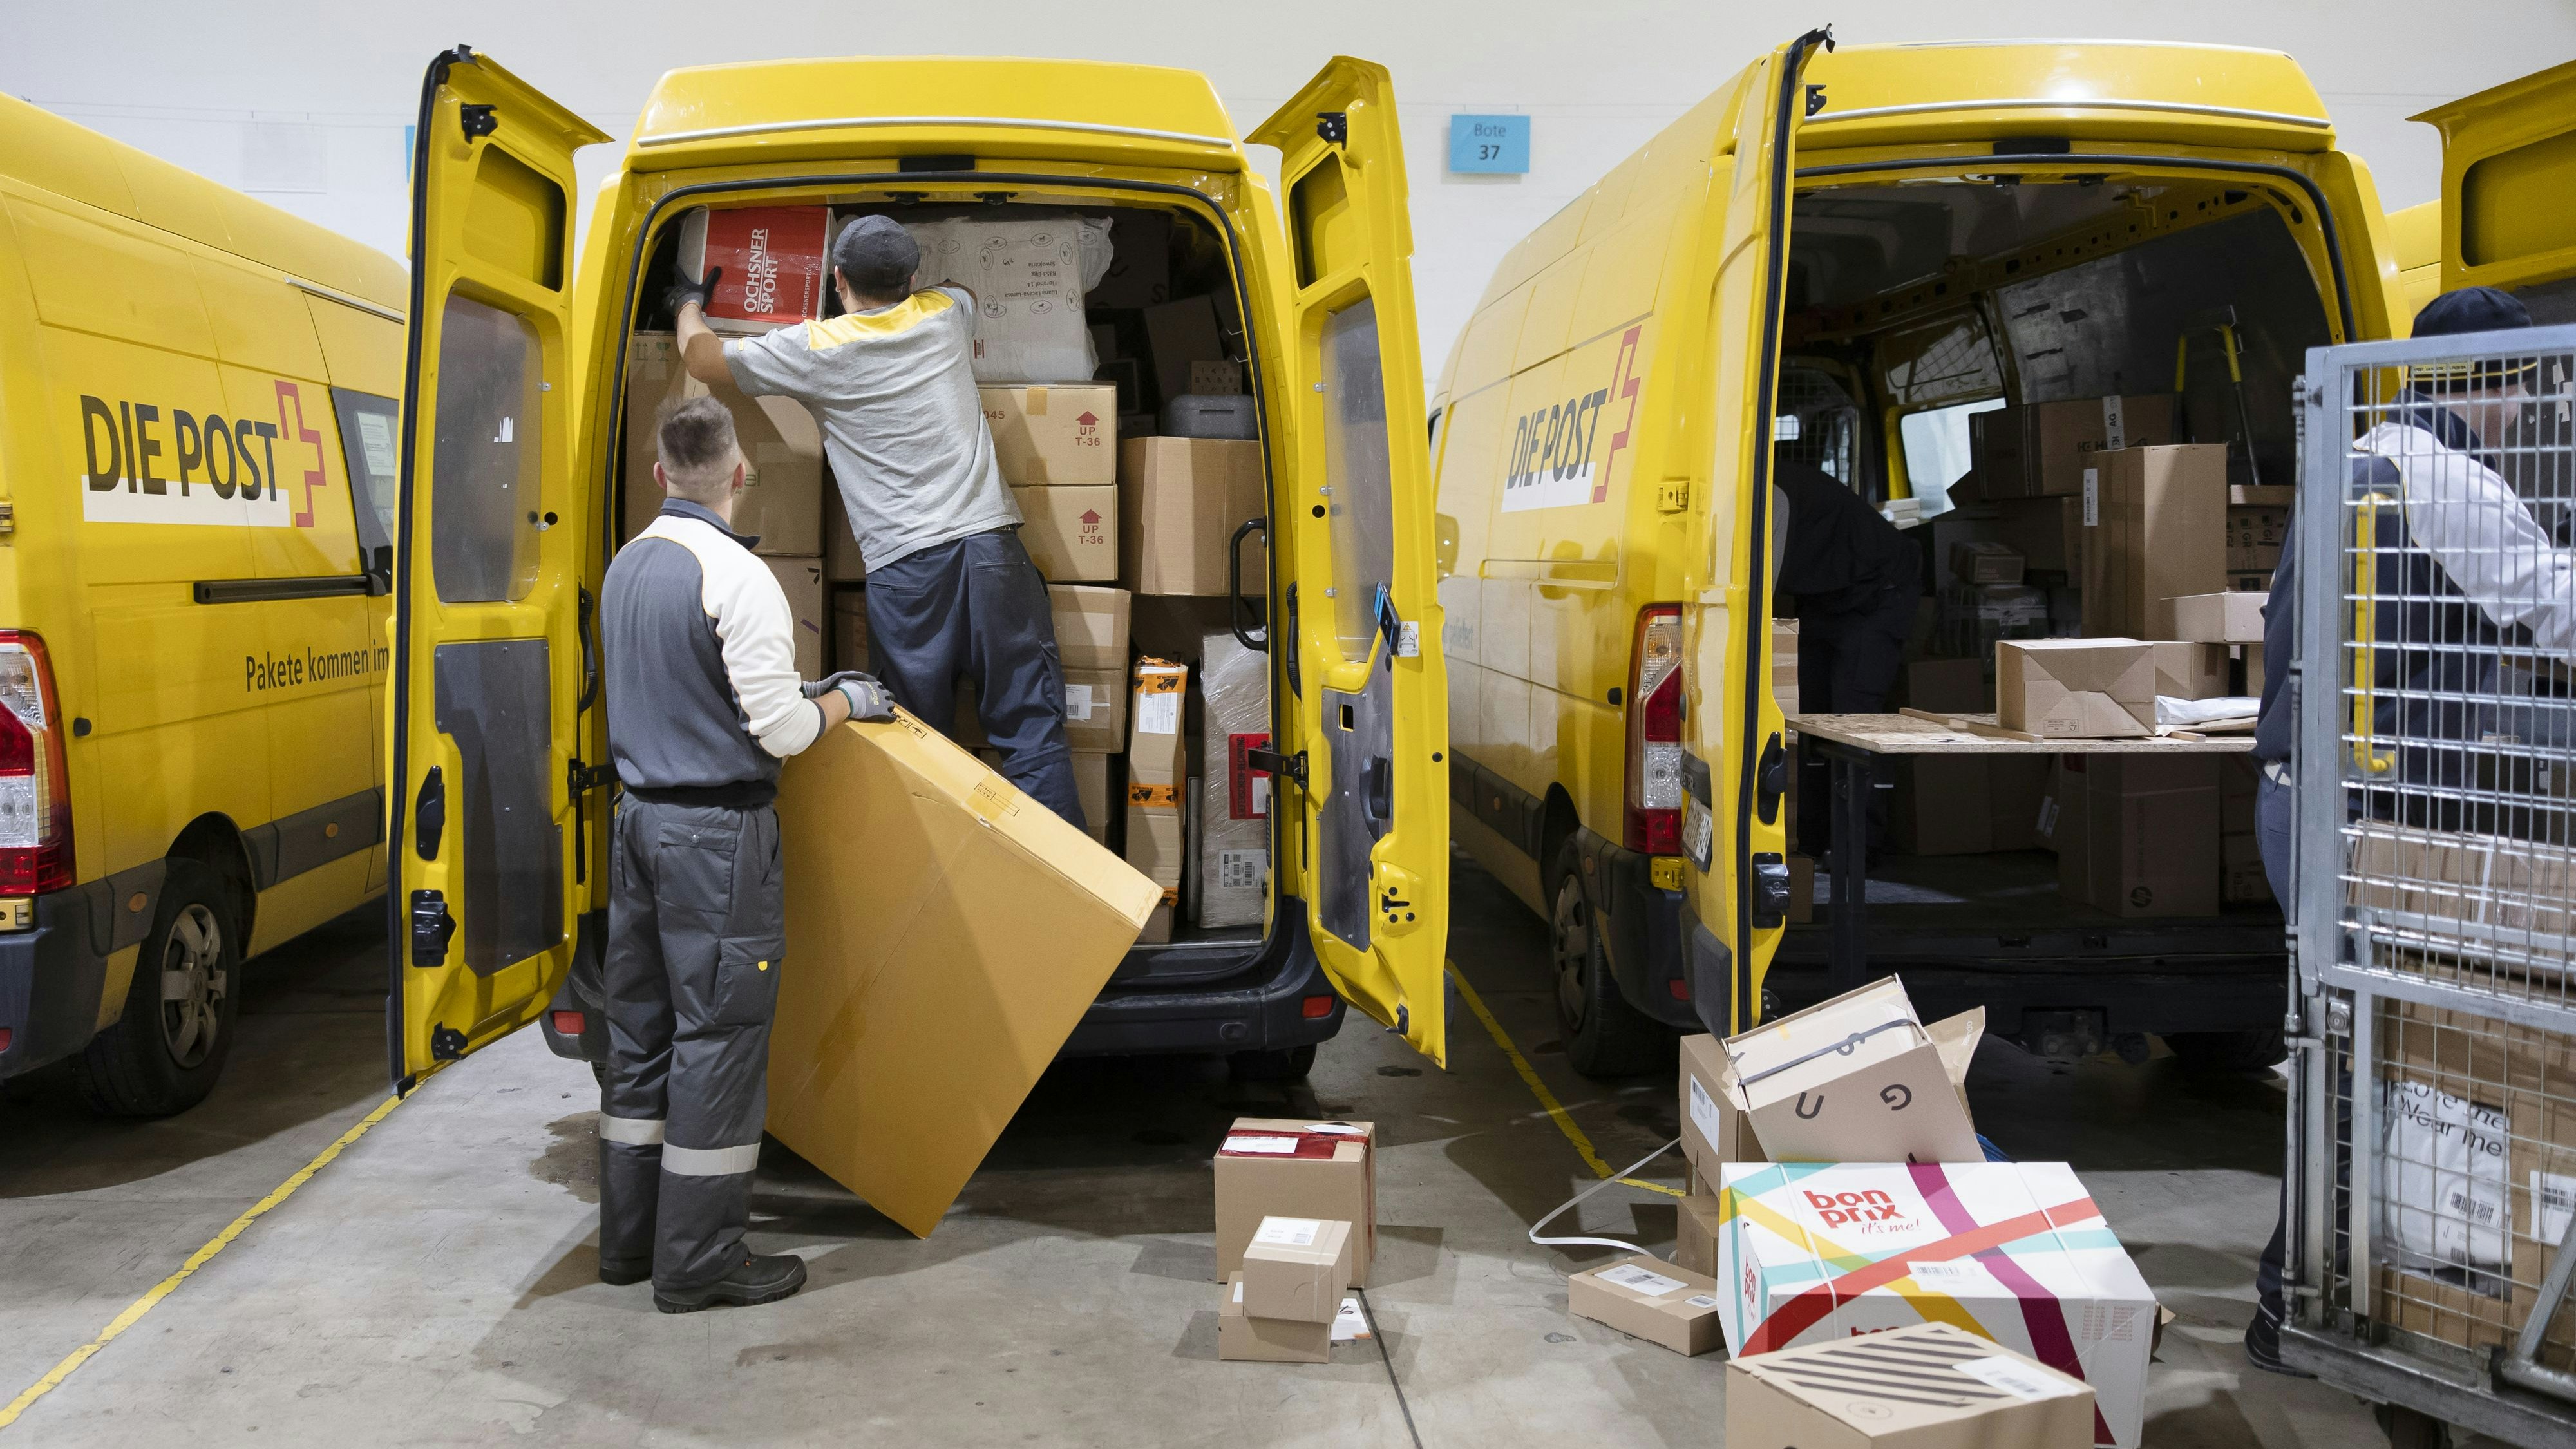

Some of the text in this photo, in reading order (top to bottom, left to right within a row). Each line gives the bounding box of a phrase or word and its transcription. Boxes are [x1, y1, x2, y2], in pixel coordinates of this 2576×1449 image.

[1473, 123, 1507, 138] Bote
[1479, 145, 1500, 160] 37
[744, 228, 766, 313] OCHSNER
[760, 256, 779, 314] SPORT
[801, 263, 812, 317] OCHSNERSPORT.CH
[1075, 437, 1101, 446] T-36
[1079, 426, 1095, 436] UP
[1507, 387, 1608, 489] DIE POST
[80, 395, 167, 496] DIE
[173, 409, 278, 502] POST
[1078, 535, 1103, 544] T-36
[1083, 525, 1099, 534] UP
[246, 639, 389, 692] Pakete kommen im
[1880, 1083, 1912, 1111] G
[2401, 1094, 2503, 1157] Wear me
[1803, 1188, 1894, 1209] bon
[1818, 1203, 1906, 1229] prix
[1861, 1218, 1922, 1236] it's me!
[1745, 1255, 1756, 1294] bon
